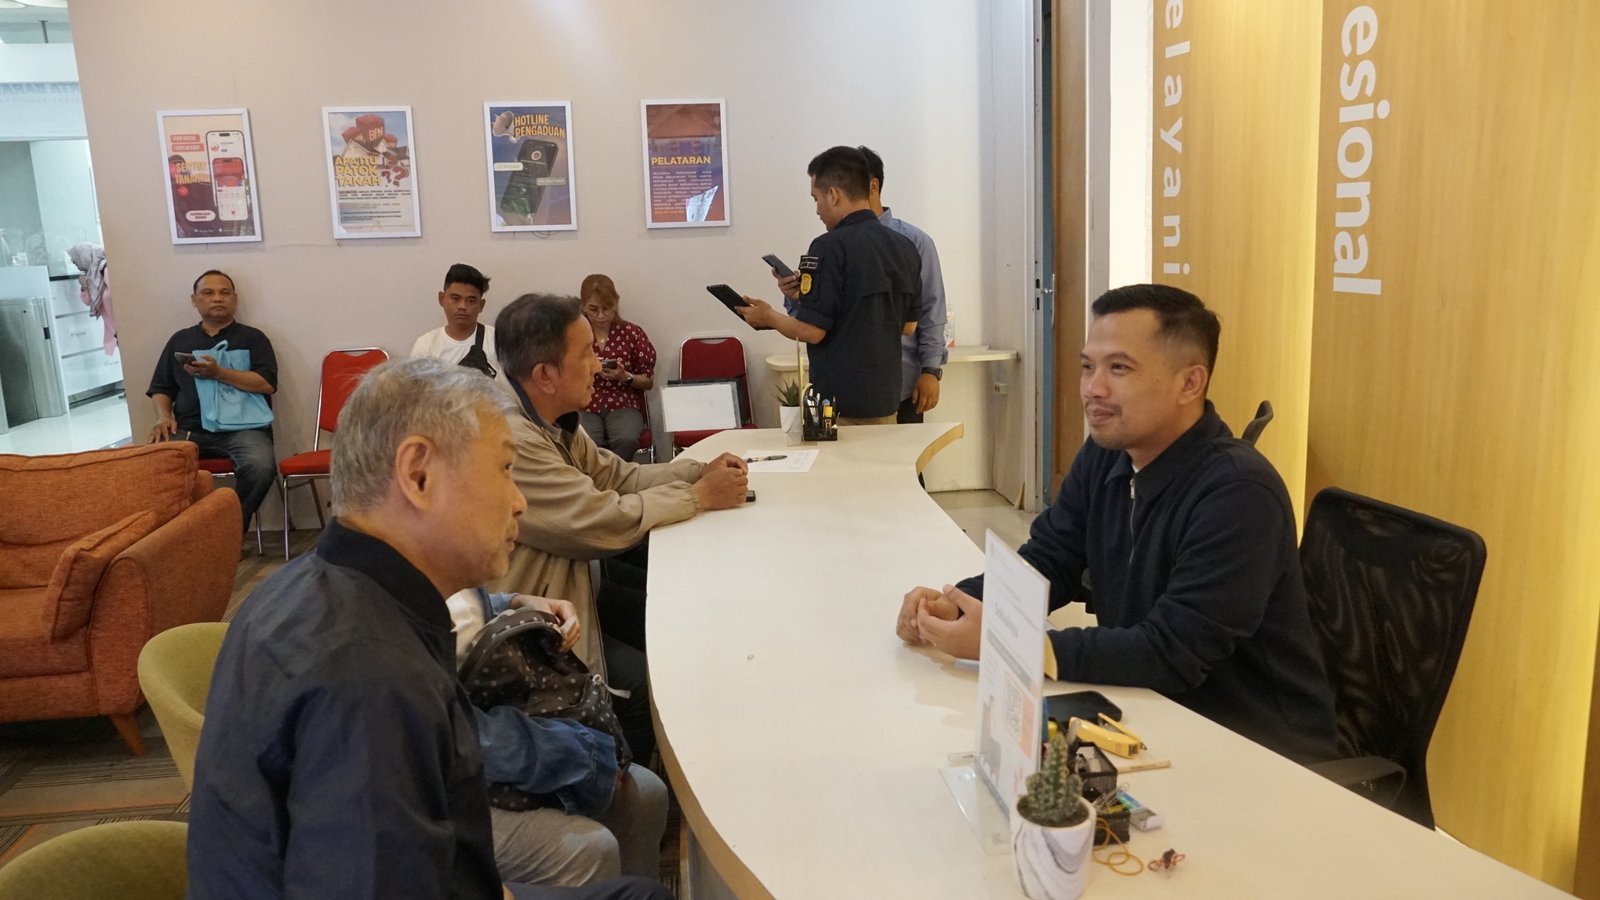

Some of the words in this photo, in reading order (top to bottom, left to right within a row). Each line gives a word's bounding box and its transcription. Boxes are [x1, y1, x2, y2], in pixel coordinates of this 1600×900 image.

[514, 114, 550, 126] HOTLINE
[515, 125, 565, 138] PENGADUAN
[1160, 0, 1190, 275] elayani
[1332, 5, 1390, 295] esional
[651, 156, 711, 165] PELATARAN
[335, 165, 377, 176] PATOK
[335, 175, 381, 187] TANAH
